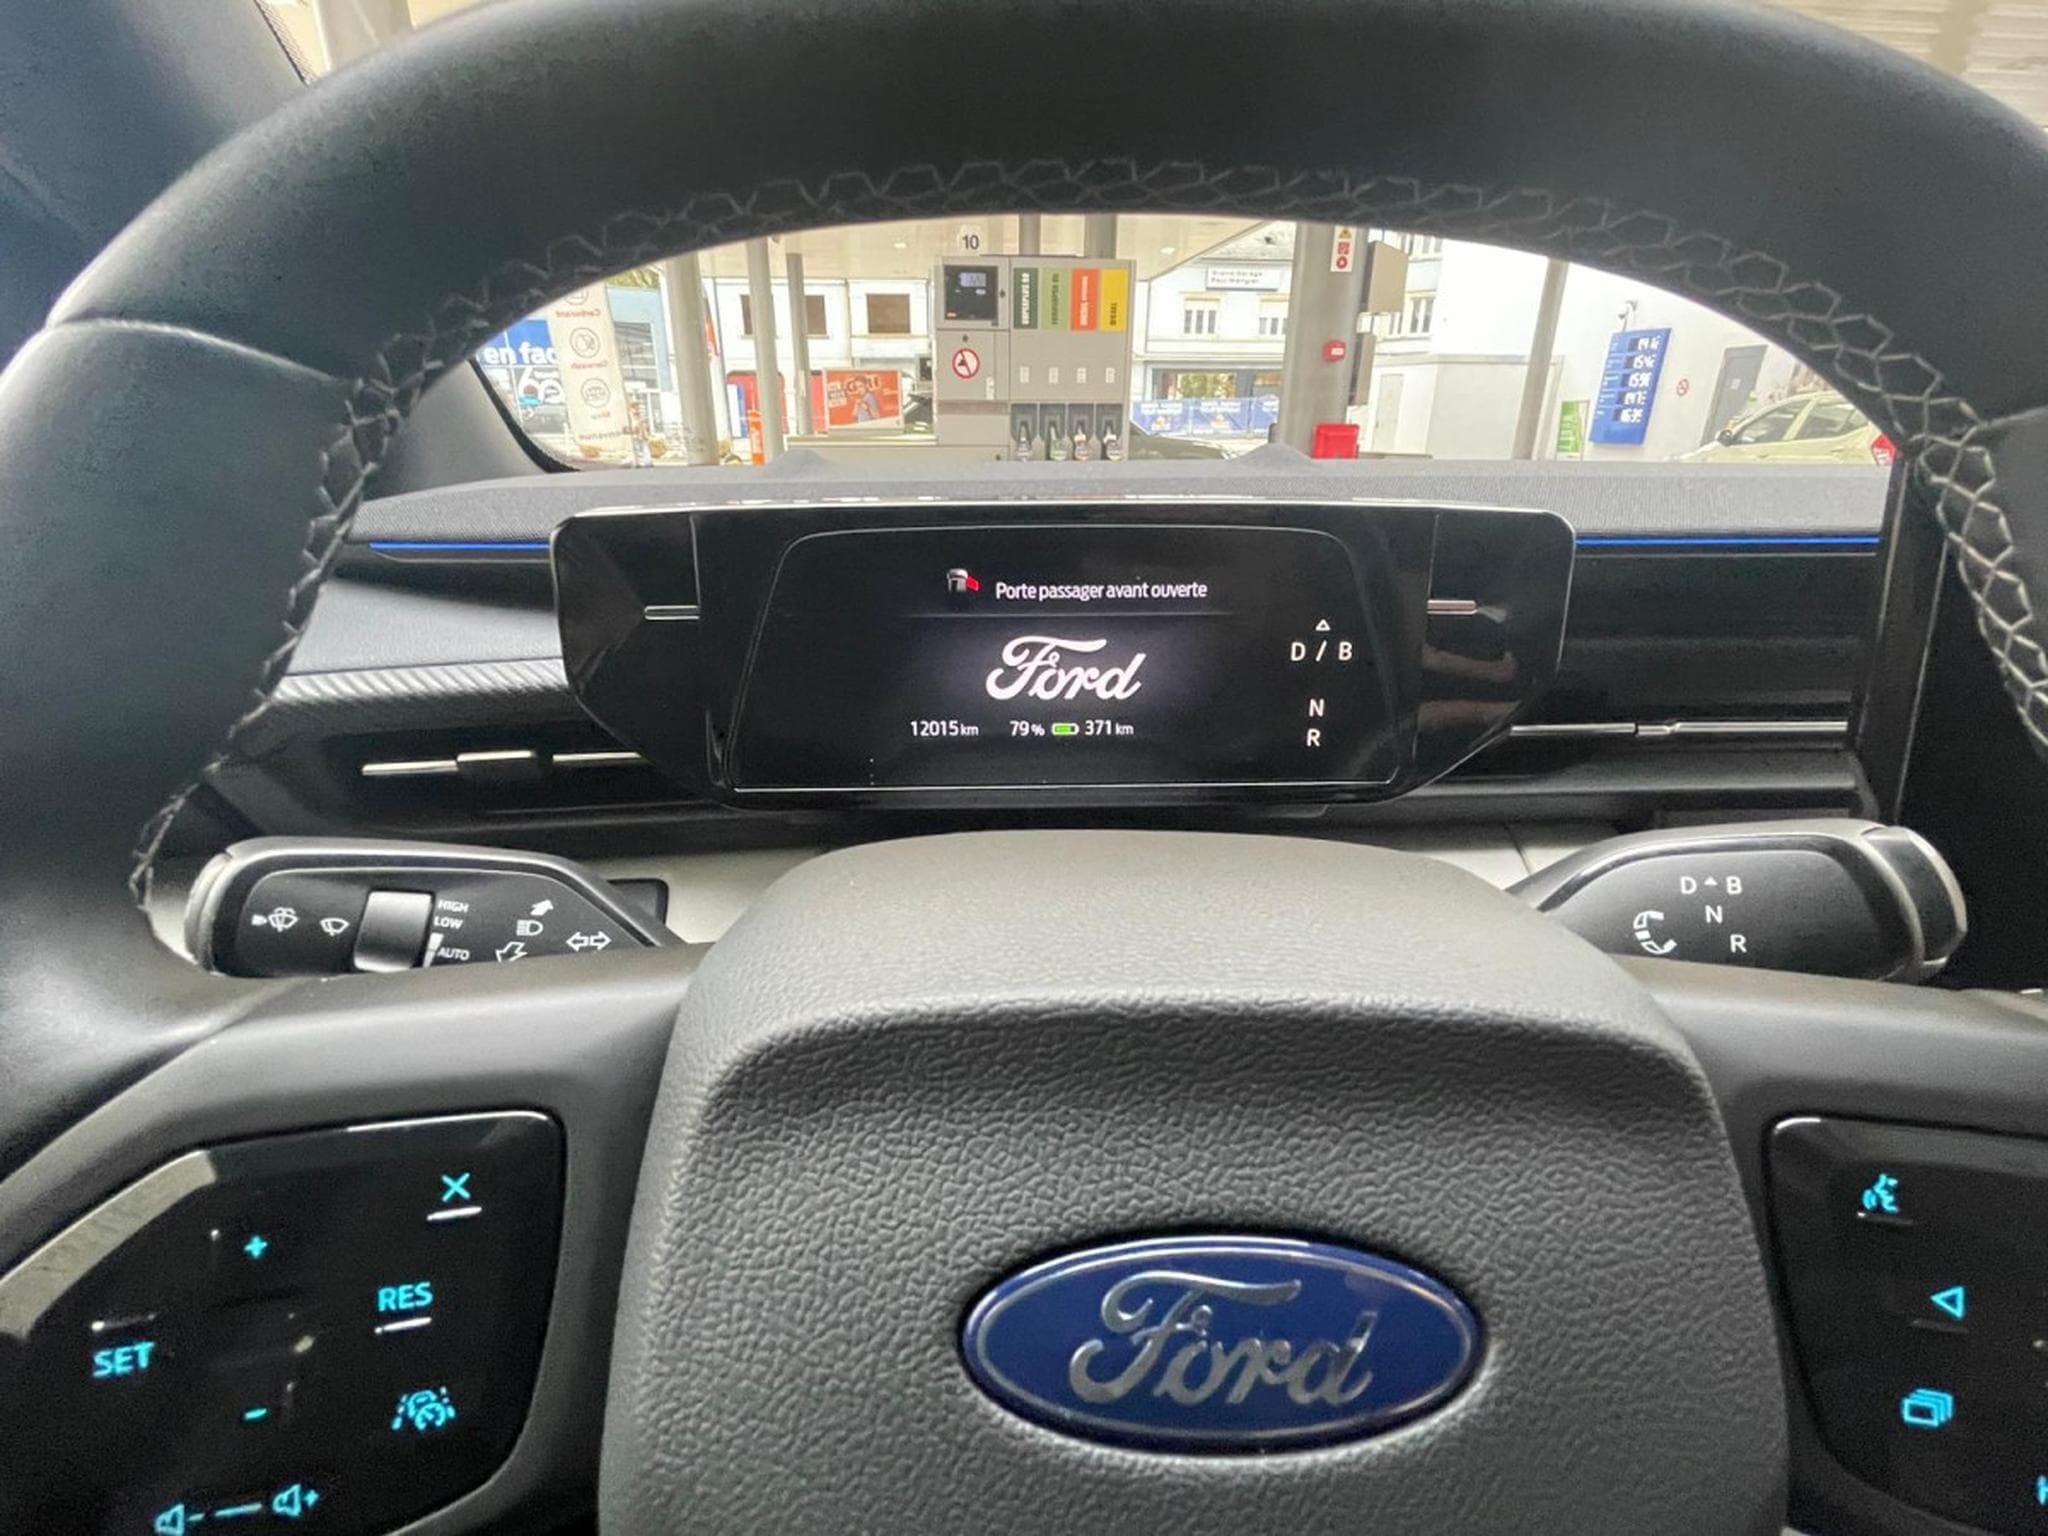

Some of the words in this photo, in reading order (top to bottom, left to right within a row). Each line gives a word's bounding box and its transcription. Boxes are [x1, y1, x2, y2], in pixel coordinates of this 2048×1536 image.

[962, 235, 980, 250] 10
[485, 347, 517, 364] en
[995, 582, 1036, 599] Porte
[1038, 583, 1105, 602] passager
[1106, 582, 1149, 598] avant
[1151, 582, 1208, 598] ouverte
[1291, 642, 1305, 661] D
[1339, 642, 1352, 661] B
[985, 635, 1147, 700] Ford
[1309, 700, 1324, 717] N
[1084, 719, 1111, 736] 371
[1115, 722, 1134, 736] km
[1307, 729, 1321, 747] R
[1680, 876, 1698, 895] D
[1726, 876, 1743, 895] B
[438, 899, 469, 913] HIGH
[1706, 905, 1723, 922] N
[433, 916, 464, 929] LOW
[1730, 933, 1746, 952] R
[438, 947, 470, 961] AUTO
[377, 1282, 433, 1312] RES
[1069, 1270, 1378, 1406] Ford
[93, 1342, 155, 1378] SET
